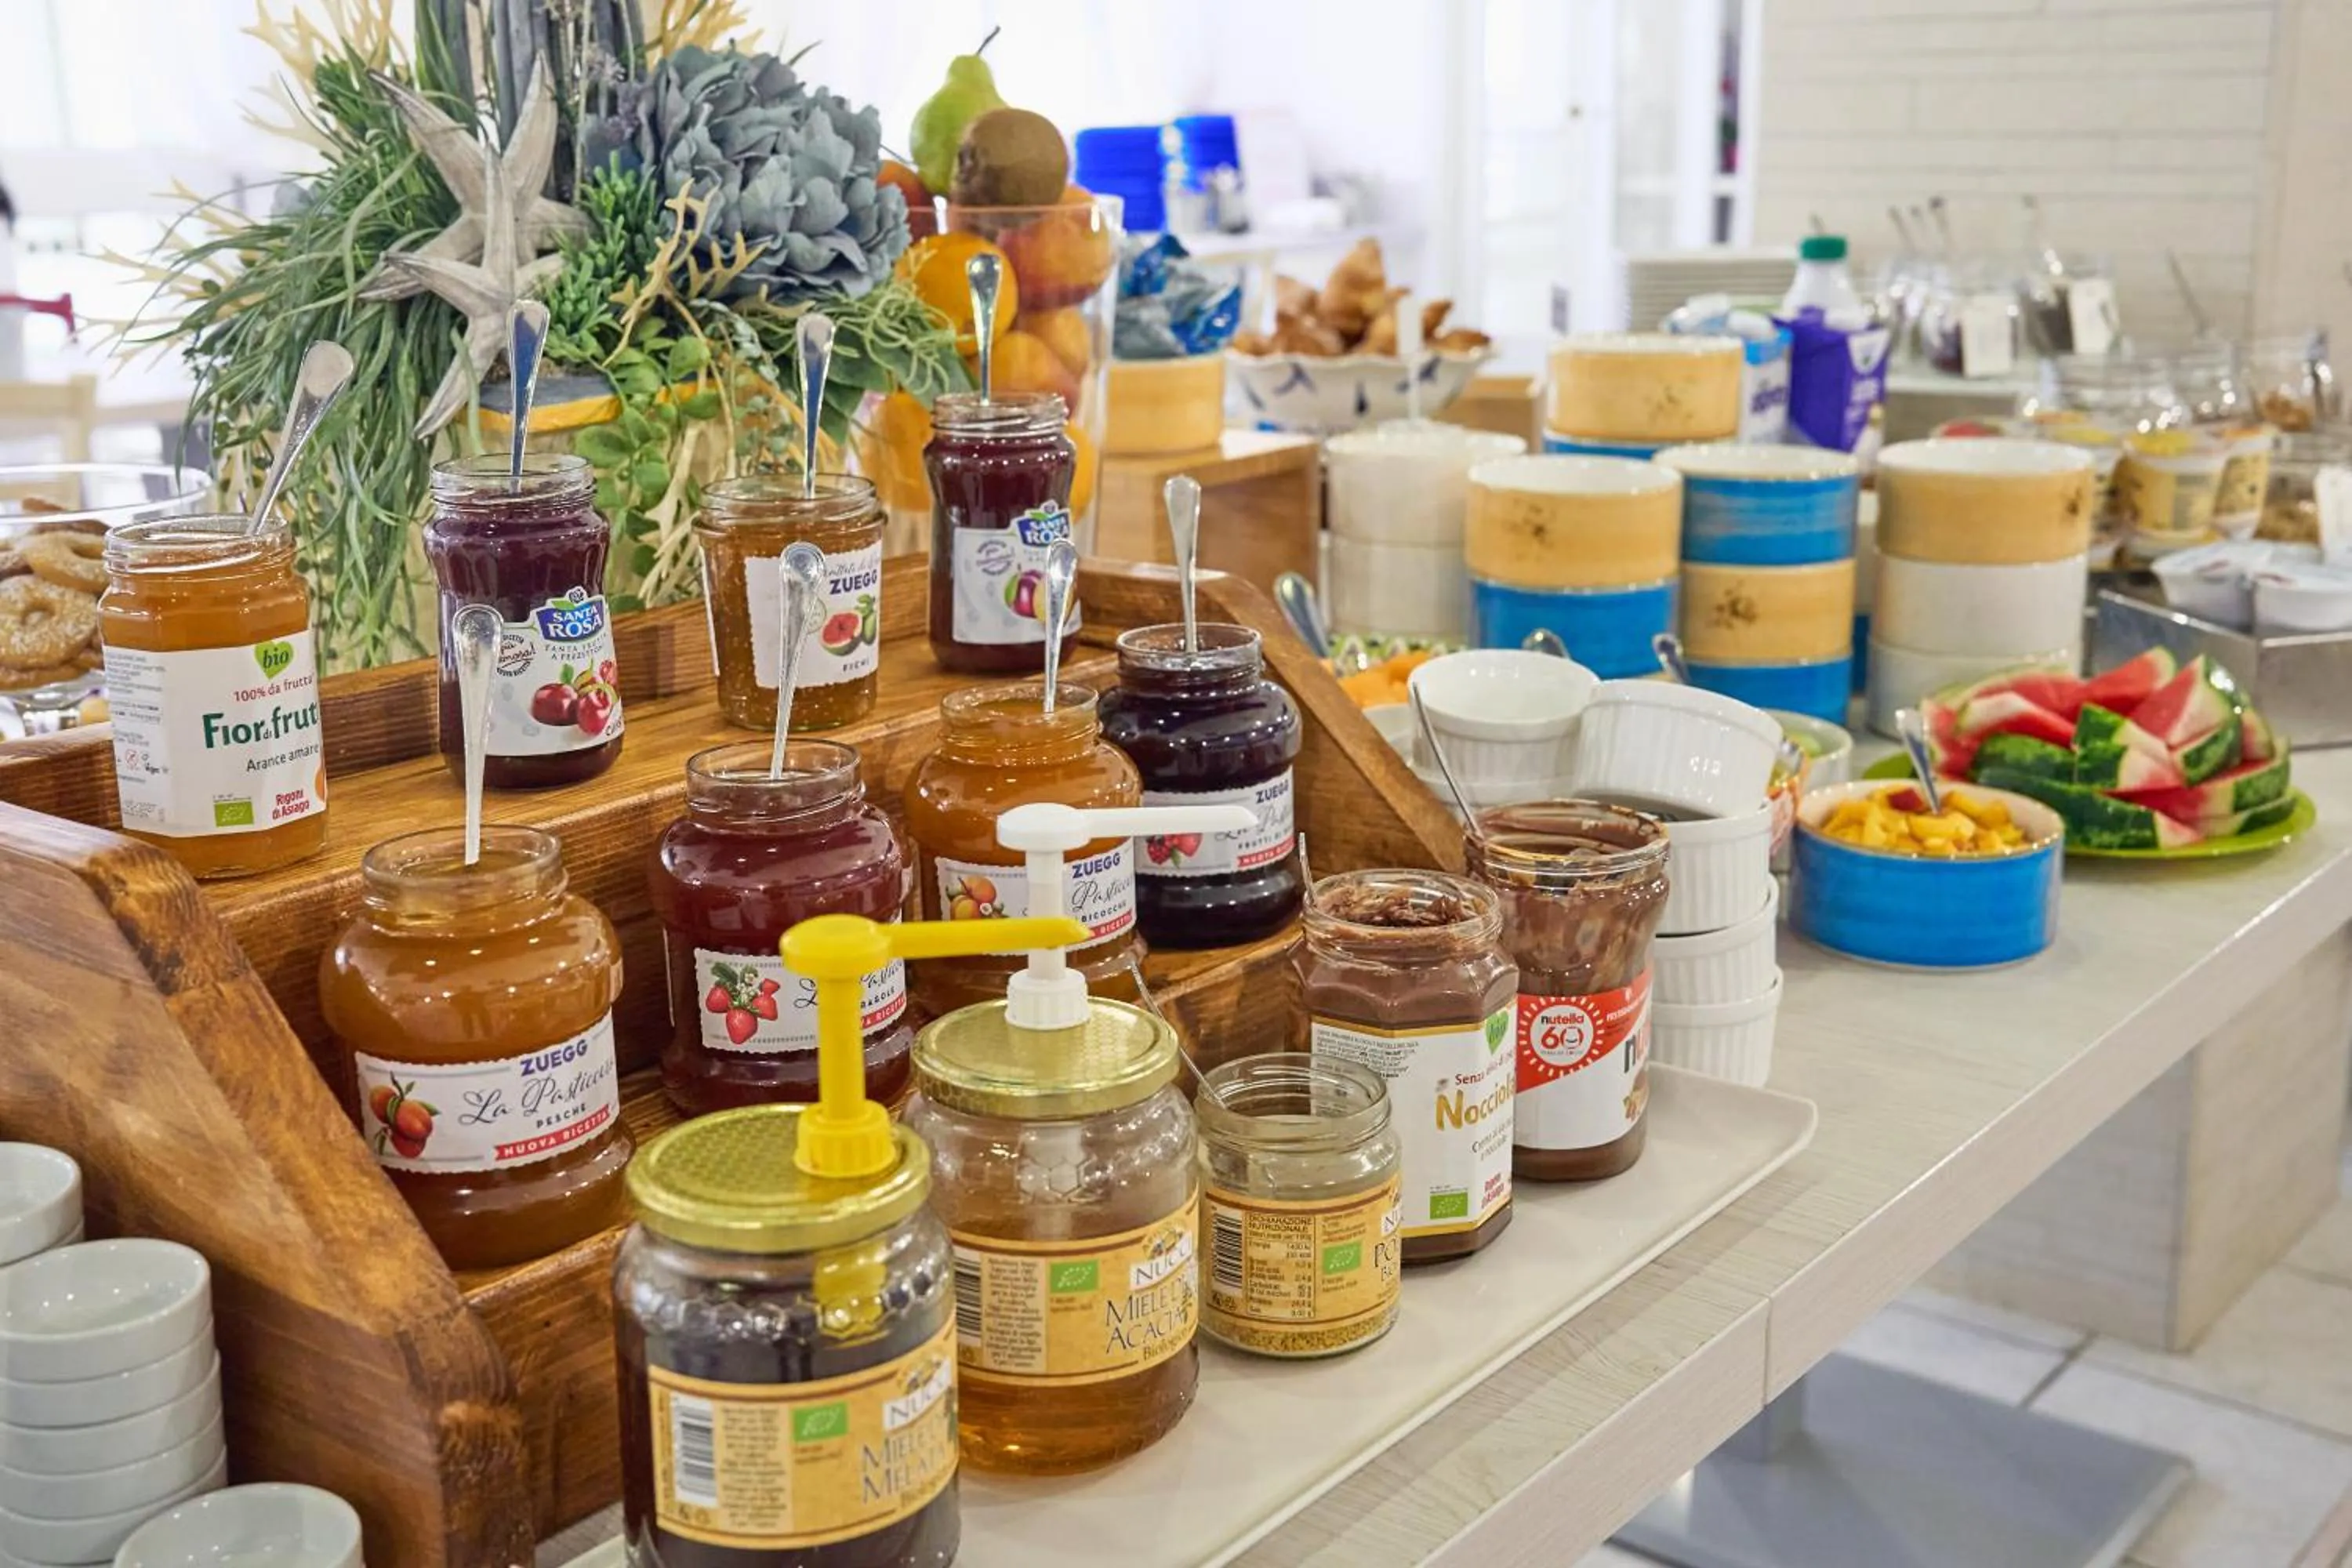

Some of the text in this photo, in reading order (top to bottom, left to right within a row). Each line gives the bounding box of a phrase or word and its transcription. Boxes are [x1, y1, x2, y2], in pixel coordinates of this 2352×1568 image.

[829, 569, 877, 595] ZUEGG
[546, 614, 603, 637] ROSA
[553, 604, 598, 622] SANTA
[263, 647, 289, 670] bio
[234, 687, 266, 702] 100%
[267, 682, 281, 696] da
[272, 702, 318, 740] frut
[246, 751, 287, 772] Arance
[1072, 852, 1121, 879] ZUEGG
[1541, 1012, 1585, 1025] nutella
[1541, 1026, 1584, 1050] 60
[519, 1038, 589, 1077] ZUEGG
[458, 1088, 512, 1126] La
[535, 1102, 586, 1129] PESCHE
[504, 1111, 608, 1157] NUOVA RICETTA
[1105, 1285, 1169, 1327] MIELE
[1105, 1305, 1184, 1355] ACACIA
